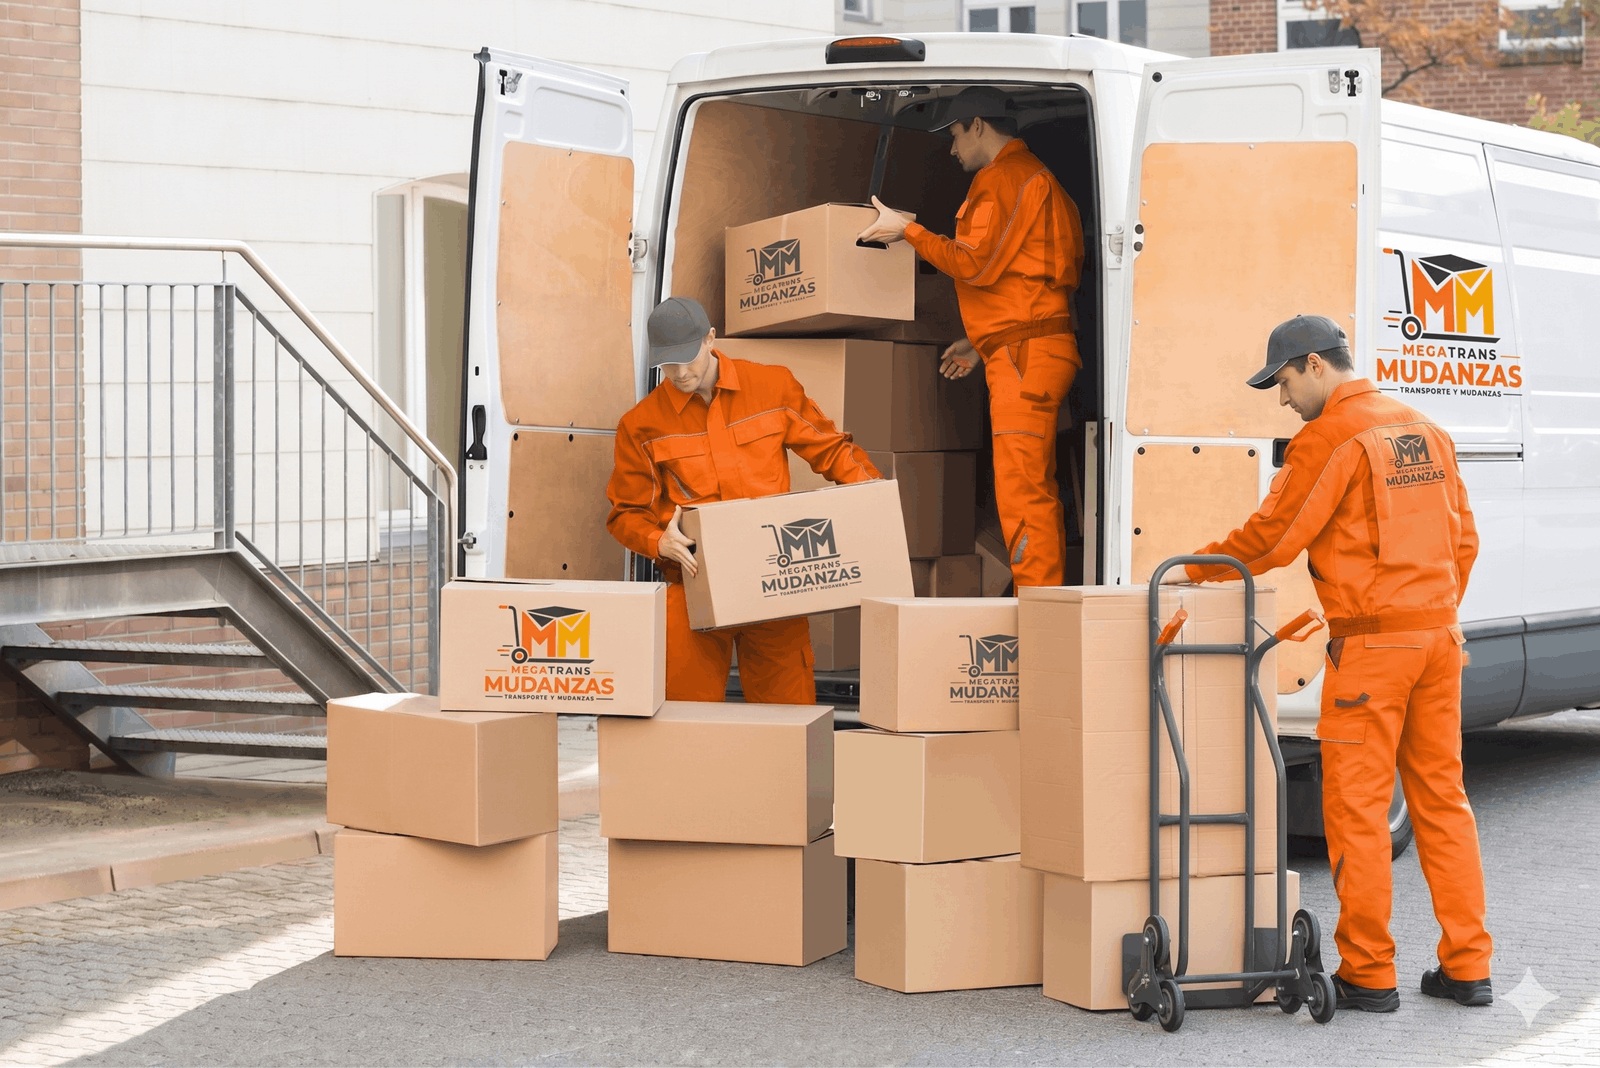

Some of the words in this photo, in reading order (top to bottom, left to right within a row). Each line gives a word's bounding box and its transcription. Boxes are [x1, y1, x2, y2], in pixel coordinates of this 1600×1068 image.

[740, 281, 816, 310] MUDANZAS
[1402, 343, 1497, 360] MEGATRANS
[1376, 358, 1523, 388] MUDANZAS
[1400, 386, 1451, 395] TRANSPORTE
[1460, 389, 1502, 397] MUDANZAS
[1385, 470, 1446, 486] MUDANZAS
[779, 560, 841, 576] MEGATRANS
[761, 566, 862, 593] MUDANZAS
[511, 665, 591, 676] MEGATRANS
[484, 675, 615, 695] MUDANZAS
